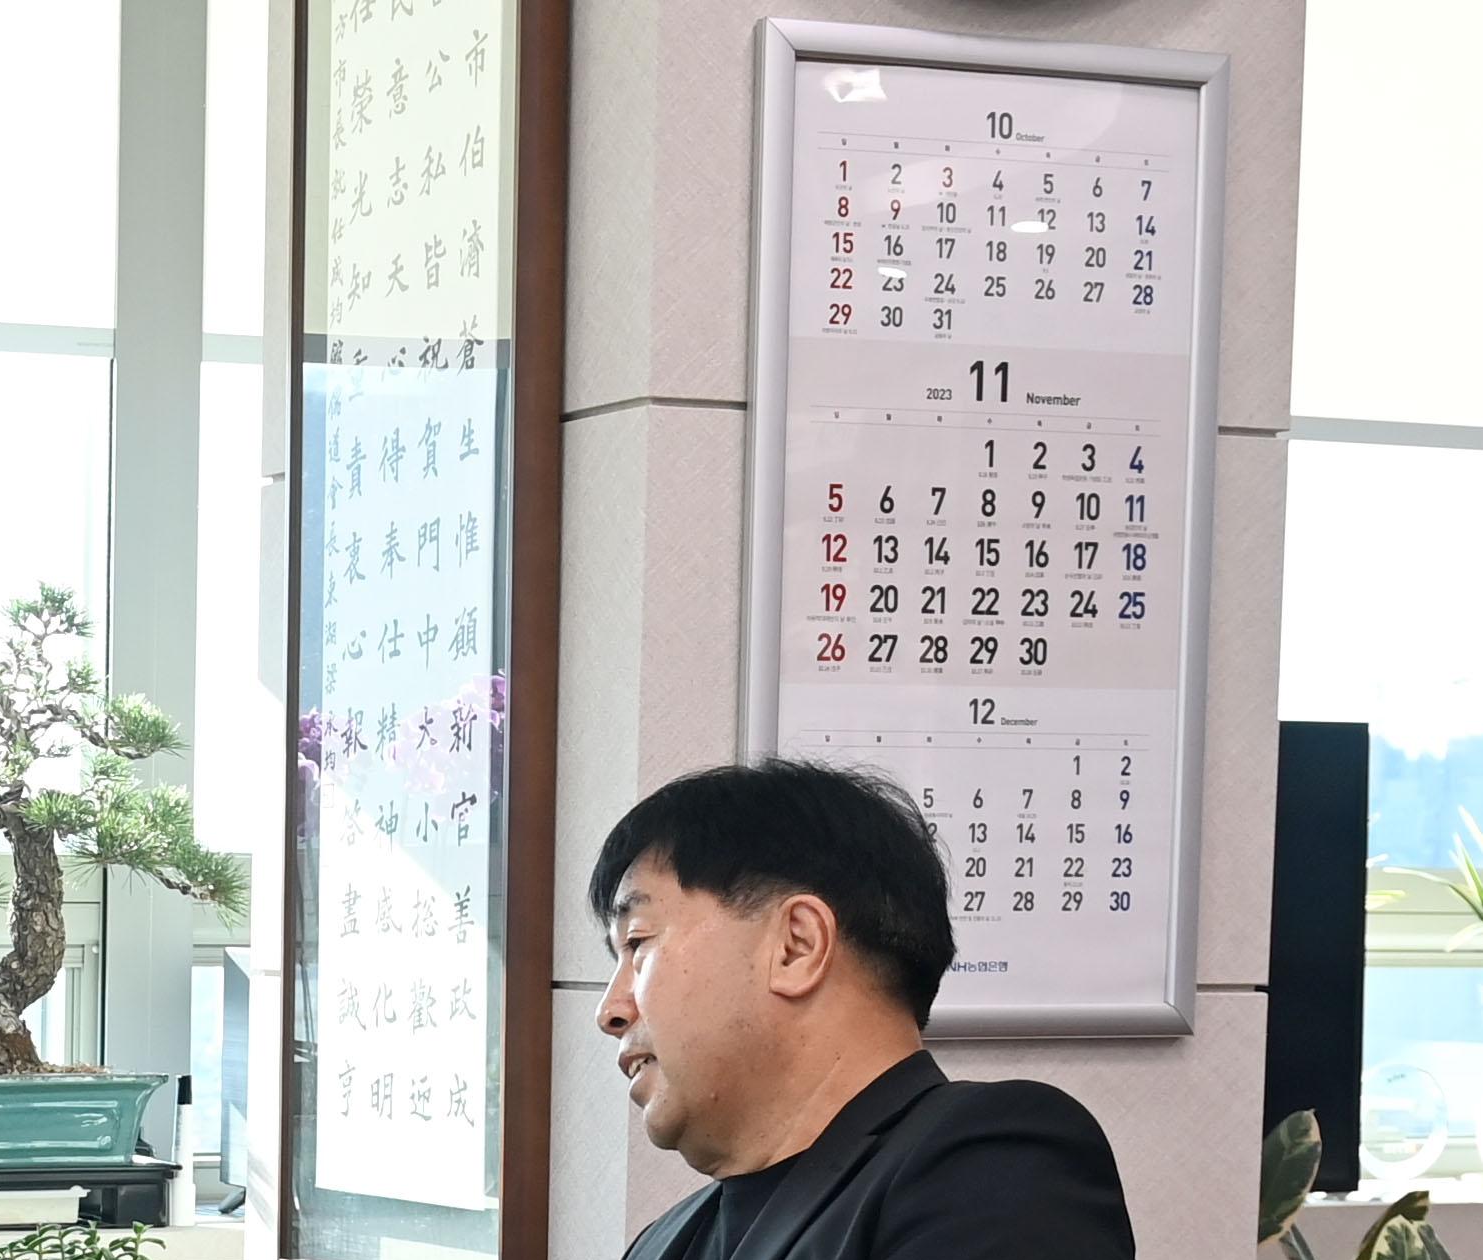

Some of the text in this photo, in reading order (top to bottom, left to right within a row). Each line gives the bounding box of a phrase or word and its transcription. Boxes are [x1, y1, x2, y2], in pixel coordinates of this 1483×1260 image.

[986, 111, 1046, 143] 10 October
[838, 159, 1153, 202] 1 2 3 4 5 6 7
[837, 195, 850, 219] 8
[890, 199, 902, 221] 9
[936, 201, 957, 225] 10
[986, 204, 1007, 228] 11
[1037, 207, 1057, 231] 12
[1086, 211, 1106, 234] 13
[1135, 214, 1157, 237] 14
[831, 231, 1153, 272] 15 16 17 18 19 20 21
[829, 266, 1154, 306] 22 23 24 25 26 27 28
[828, 302, 953, 331] 29 30 31
[926, 360, 1082, 407] 2023 11 November
[984, 439, 1145, 475] 1 2 3 4
[827, 482, 1146, 523] 5 6 7 8 9 10 11
[821, 532, 1147, 572] 12 13 14 15 16 17 18
[820, 582, 1146, 620] 19 20 21 22 23 24 25
[816, 632, 1048, 666] 26 27 28 29 30
[968, 698, 1038, 728] 12 December
[1072, 754, 1132, 777] 1 2
[923, 787, 1131, 811] 5 6 7 8 9
[968, 822, 988, 844] 13
[1016, 822, 1037, 844] 14
[1066, 822, 1086, 845] 15
[1114, 823, 1134, 845] 16
[964, 856, 1133, 879] 20 21 22 23
[963, 890, 1131, 912] 27 28 29 30
